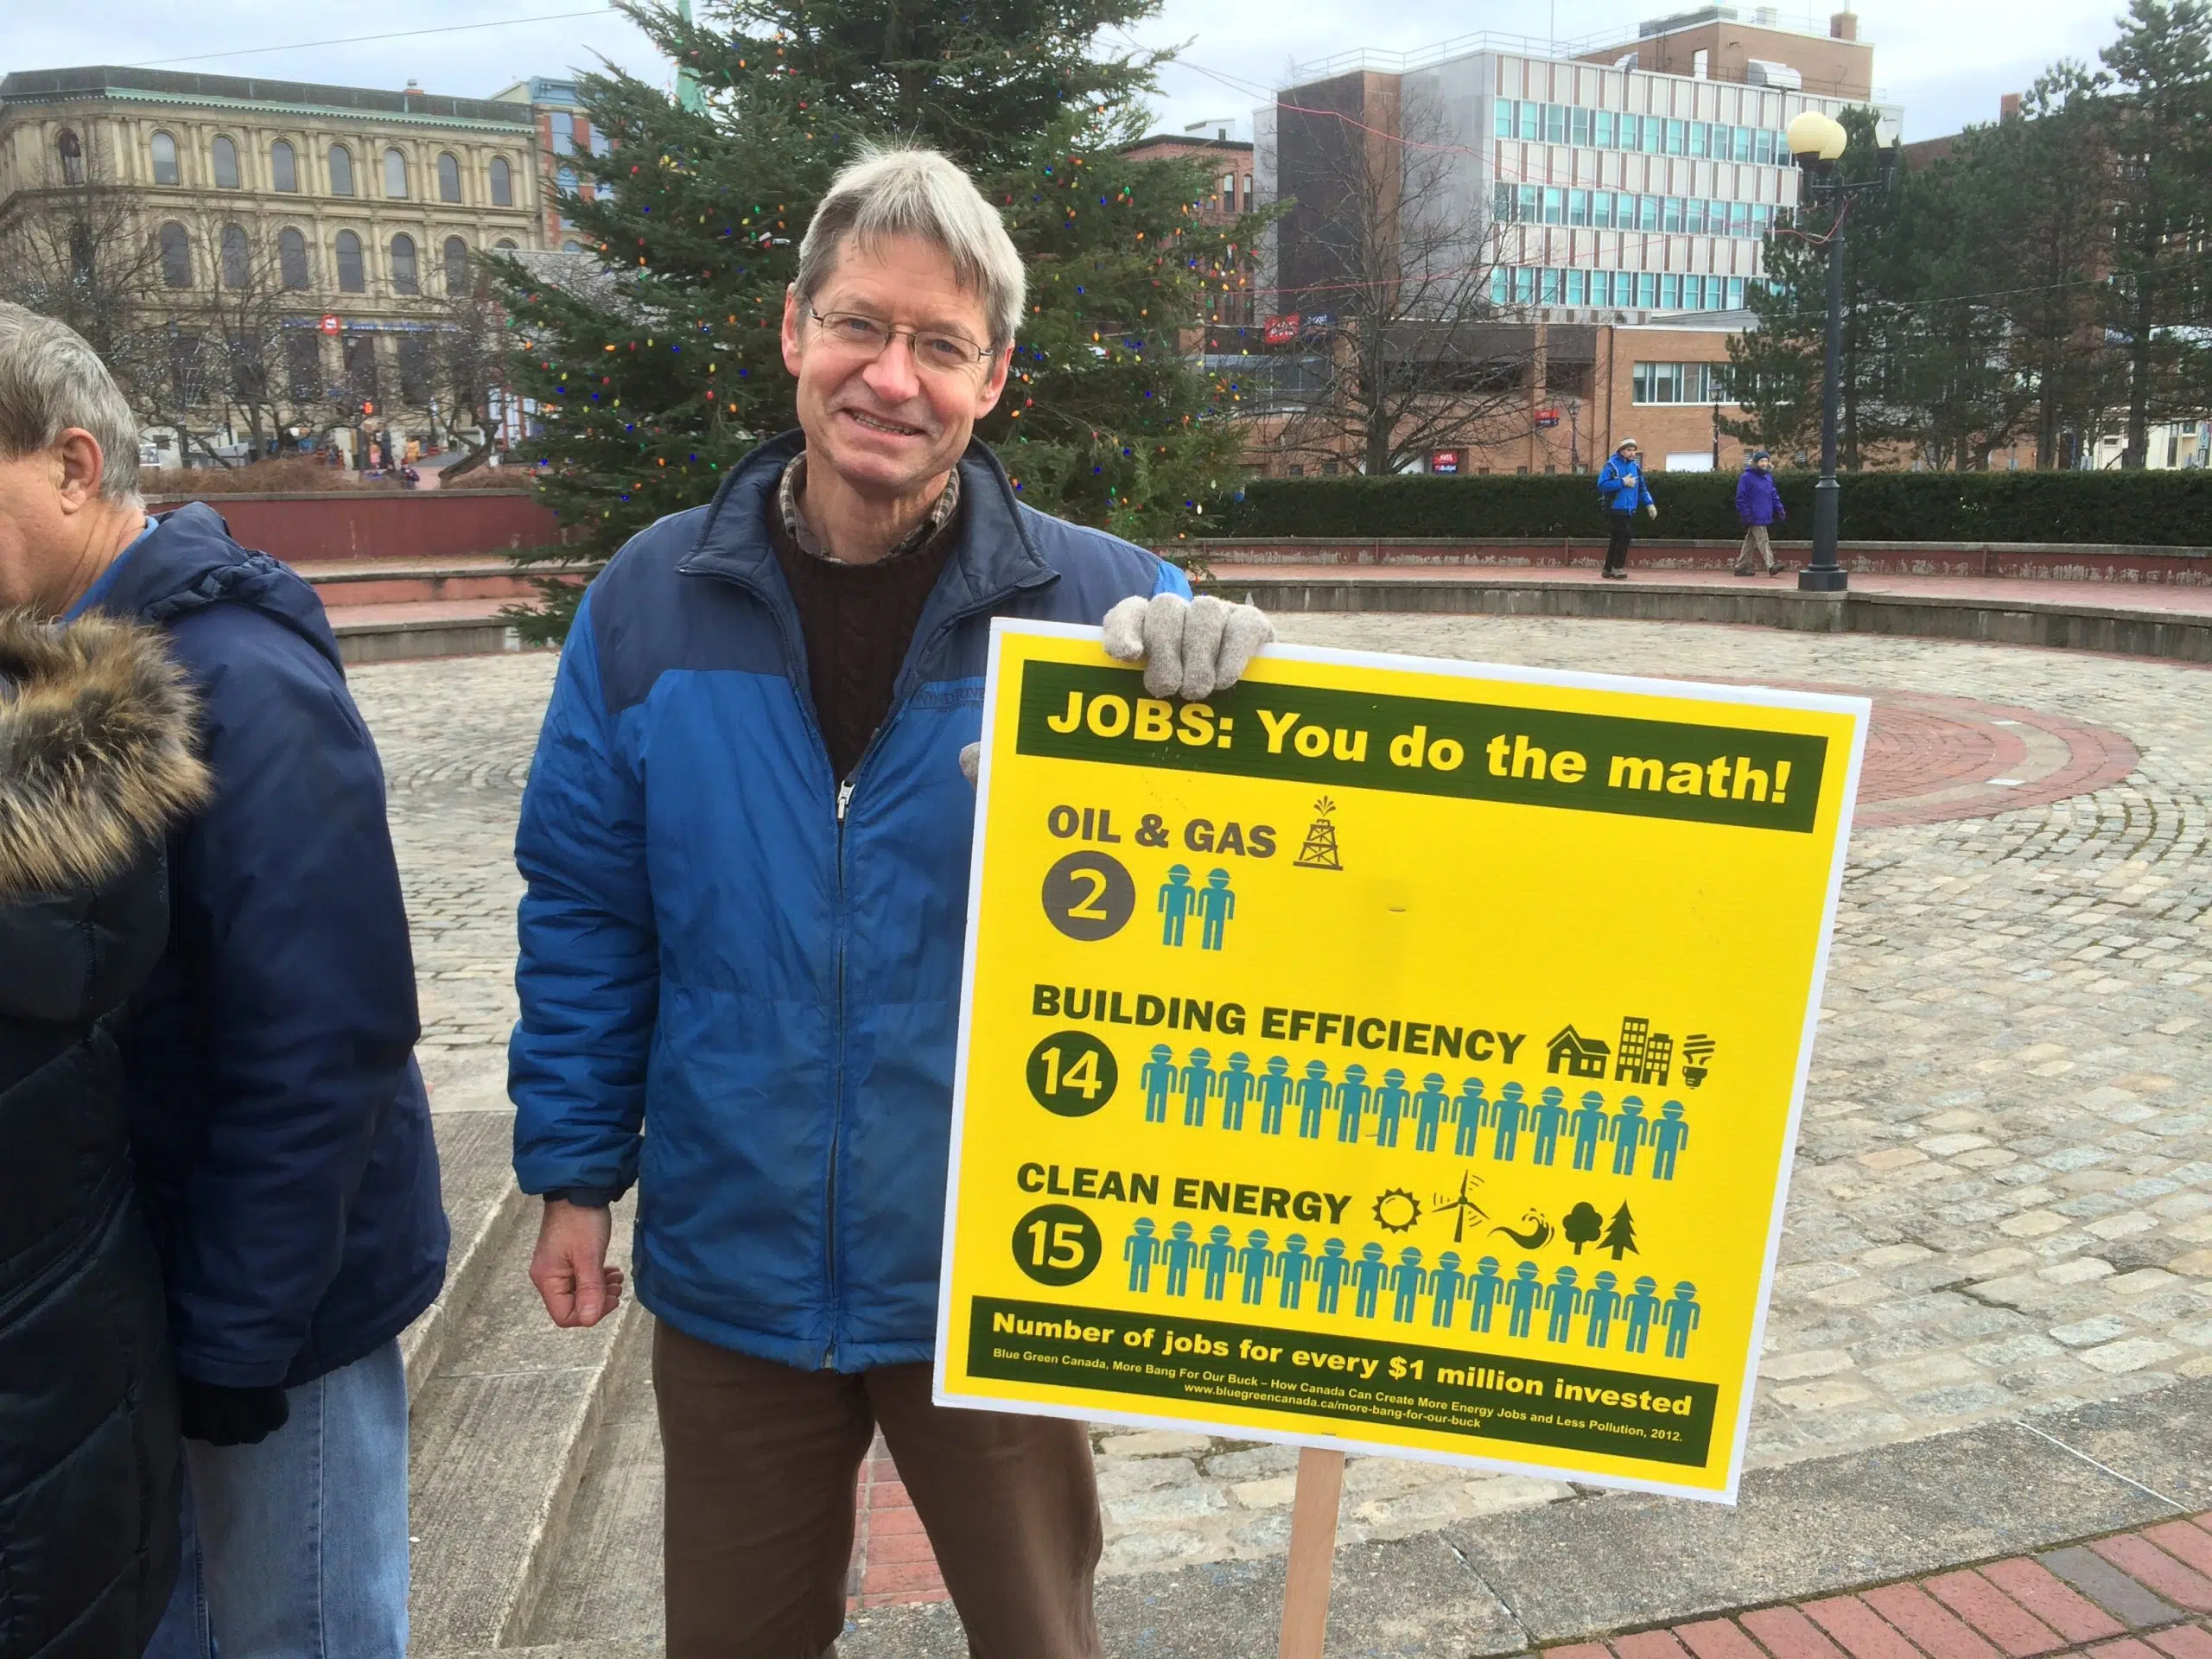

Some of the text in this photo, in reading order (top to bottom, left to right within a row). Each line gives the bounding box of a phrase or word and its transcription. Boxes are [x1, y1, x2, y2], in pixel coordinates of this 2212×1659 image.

[1047, 691, 1791, 803] JOBS: You do the math!
[1048, 805, 1275, 857] OIL & GAS
[1068, 868, 1106, 920] 2
[1033, 984, 1525, 1064] BUILDING EFFICIENCY
[1042, 1047, 1102, 1098] 14
[1018, 1163, 1351, 1224] CLEAN ENERGY
[1028, 1220, 1084, 1268] 15
[994, 1313, 1692, 1415] Number of jobs for every $1 million invested
[994, 1348, 1020, 1359] Blue
[1023, 1351, 1058, 1363] Green
[1062, 1356, 1109, 1370] Canada,
[1113, 1361, 1141, 1372] More
[1146, 1364, 1175, 1378] Bang
[1179, 1369, 1199, 1379] For
[1203, 1371, 1224, 1382] Our
[1228, 1374, 1257, 1386] Buck
[1271, 1379, 1297, 1390] How
[1300, 1382, 1344, 1396] Canada
[1349, 1389, 1371, 1400] Can
[1376, 1392, 1414, 1405] Create
[1418, 1397, 1447, 1409] More
[1452, 1402, 1494, 1417] Energy
[1497, 1408, 1527, 1420] Jobs
[1530, 1414, 1553, 1423] and
[1557, 1416, 1585, 1428] Less
[1589, 1421, 1646, 1438] Pollution,
[1651, 1429, 1682, 1441] 2012.
[1184, 1383, 1481, 1428] www.bluegreencanada.ca/more-bang-for-our-buck
